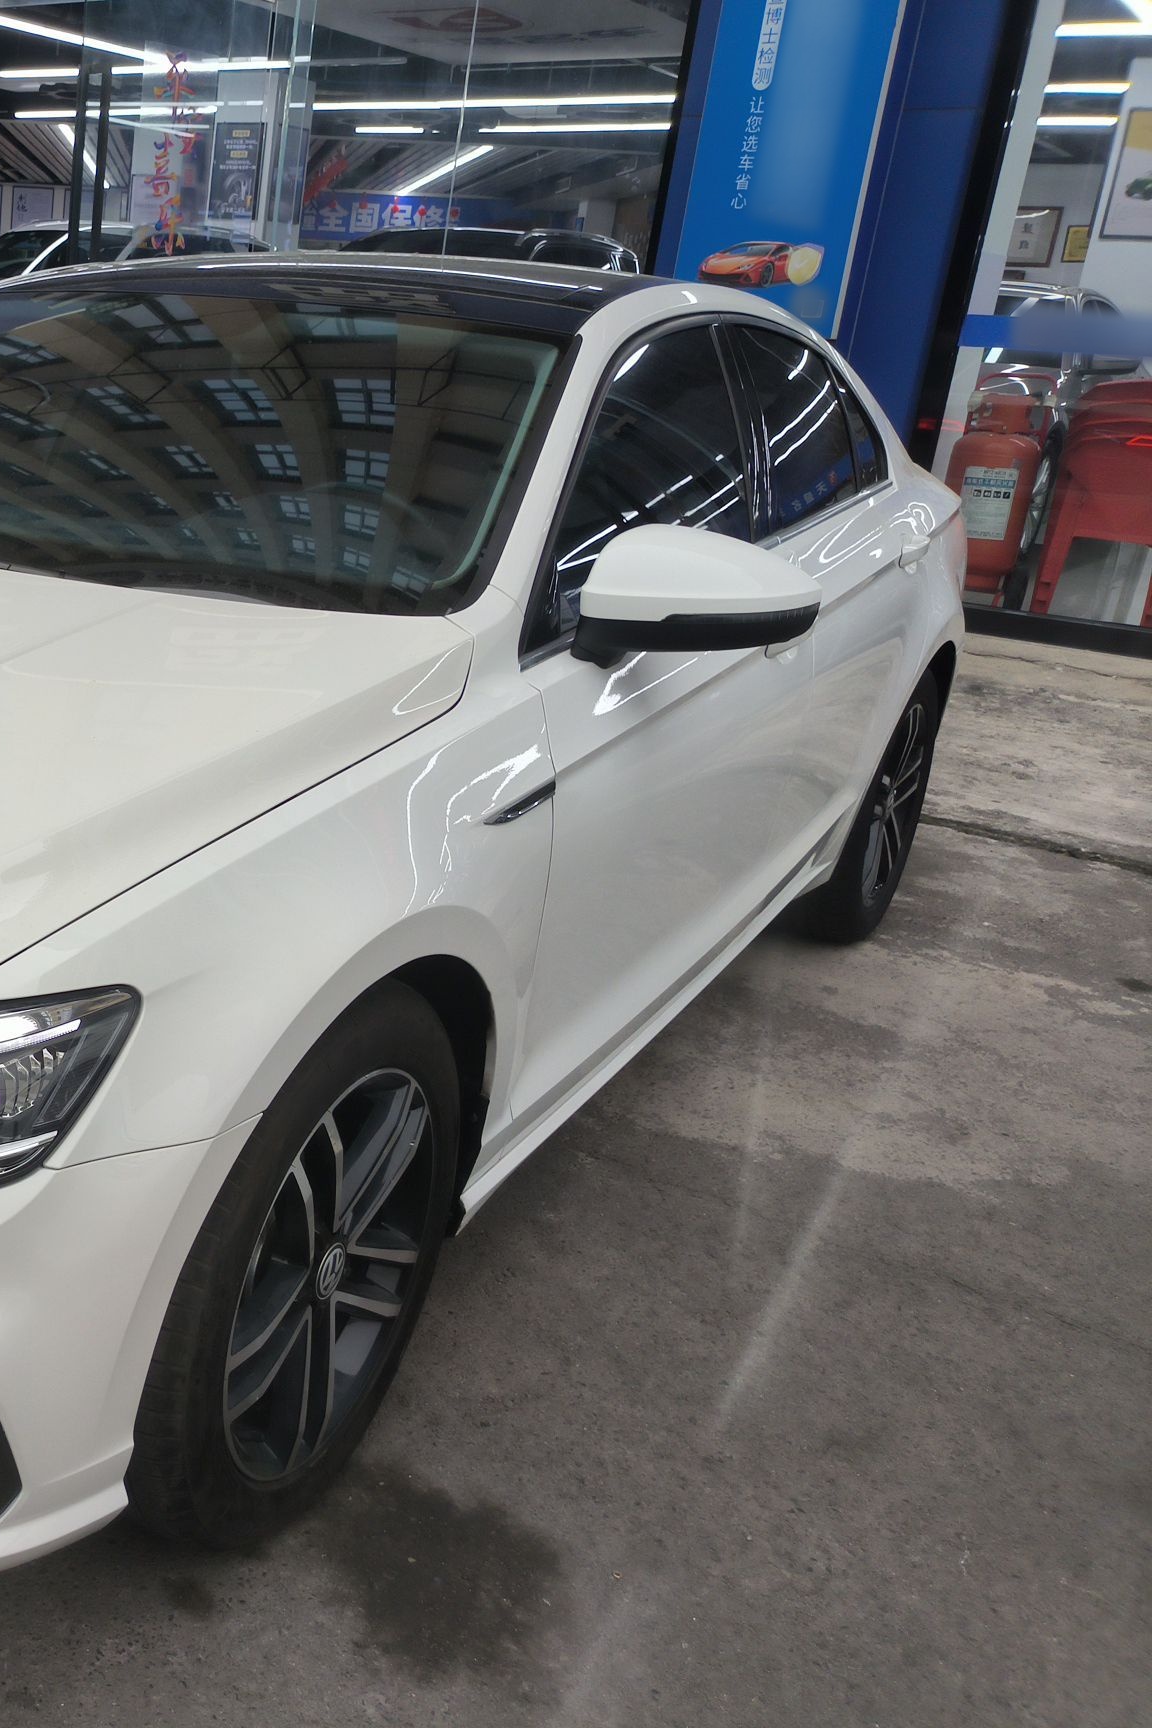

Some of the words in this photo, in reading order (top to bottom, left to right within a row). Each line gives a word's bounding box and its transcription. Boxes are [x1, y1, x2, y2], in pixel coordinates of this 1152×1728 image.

[731, 96, 765, 209] 让您选车省心
